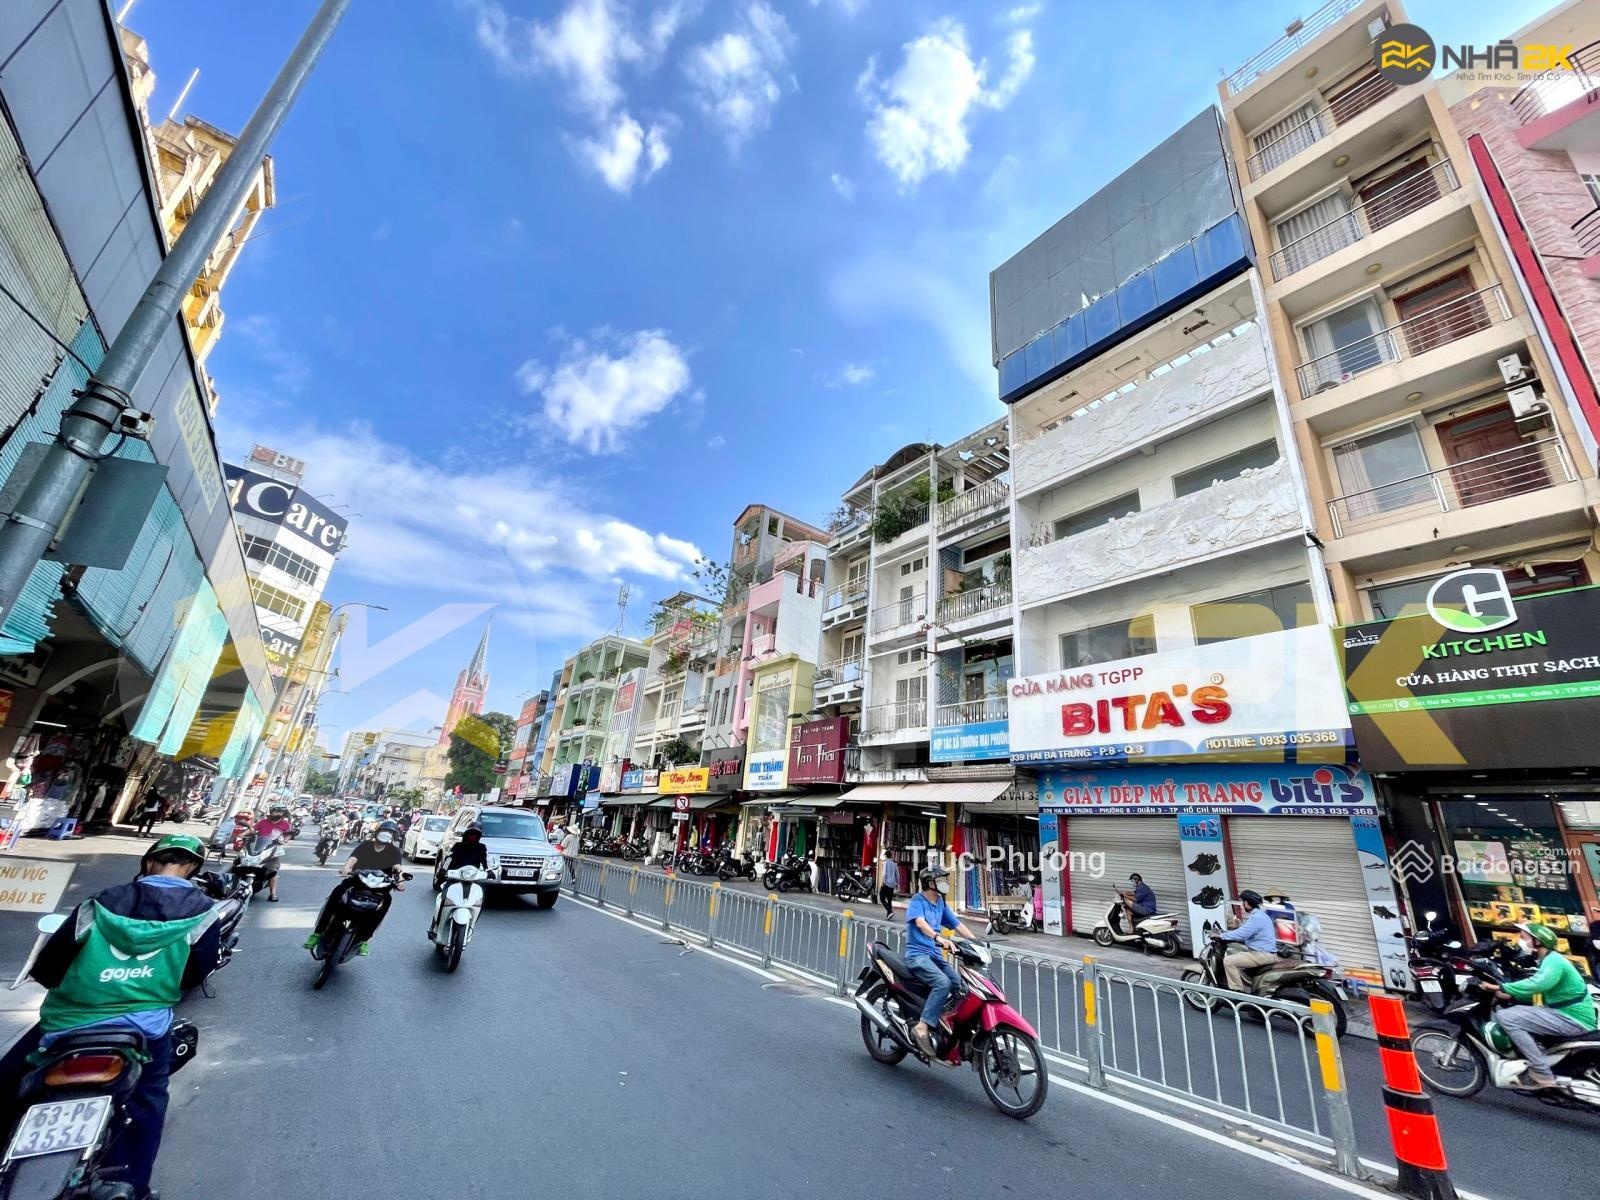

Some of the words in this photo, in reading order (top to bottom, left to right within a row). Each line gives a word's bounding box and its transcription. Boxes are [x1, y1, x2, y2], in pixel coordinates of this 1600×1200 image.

[1422, 630, 1547, 660] KITCHEN
[1012, 678, 1043, 698] CỬA
[1046, 673, 1094, 694] HÀNG
[1098, 667, 1144, 685] TGPP
[1396, 672, 1434, 687] CỬA
[1436, 667, 1489, 684] HÀNG
[1491, 663, 1539, 677] THỊT
[1543, 656, 1600, 673] SẠCH
[1061, 684, 1232, 737] BITA'S
[1206, 737, 1256, 749] HOTLINE:
[1260, 735, 1286, 746] 0933
[1289, 733, 1312, 744] 035
[1314, 731, 1338, 743] 368
[1010, 753, 1024, 762] 339
[1026, 752, 1042, 761] HAI
[1099, 747, 1116, 756] P.8
[1063, 784, 1104, 804] GIÀY
[1149, 778, 1177, 803] MỸ
[1183, 782, 1264, 804] TRANG
[29, 891, 48, 904] XE
[100, 965, 154, 982] gojek
